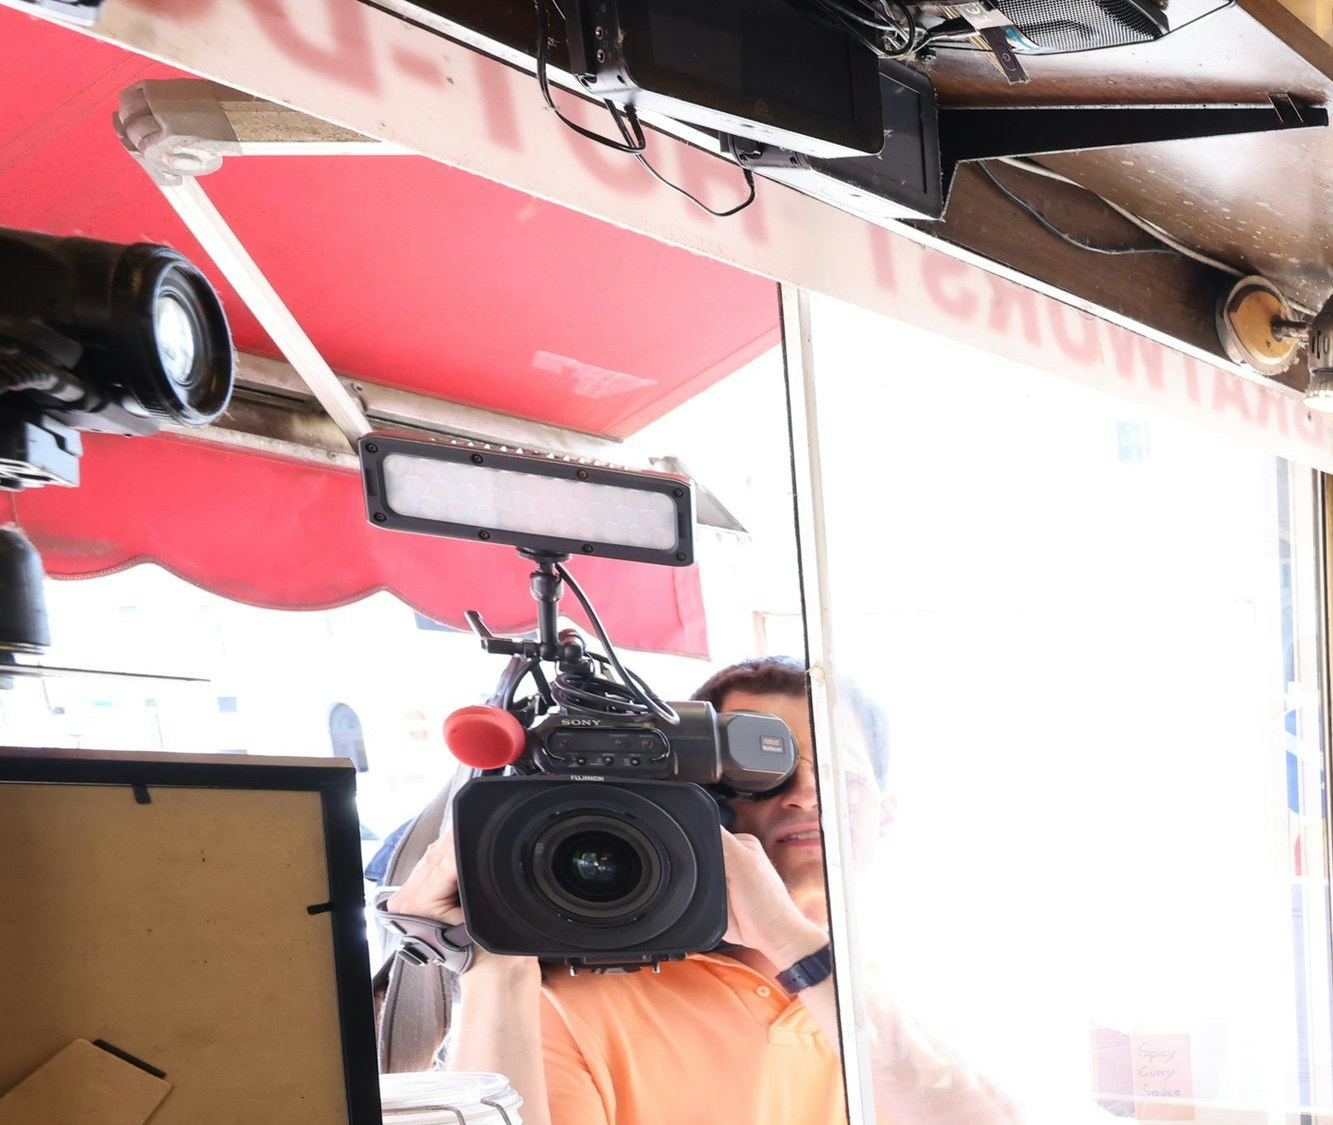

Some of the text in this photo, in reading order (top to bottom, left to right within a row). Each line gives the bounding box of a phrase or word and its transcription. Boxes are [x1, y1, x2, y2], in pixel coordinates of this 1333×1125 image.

[561, 719, 601, 727] SONY
[1136, 1041, 1177, 1064] Spicy
[1138, 1065, 1176, 1082] Curry
[1142, 1083, 1183, 1098] Sauce
